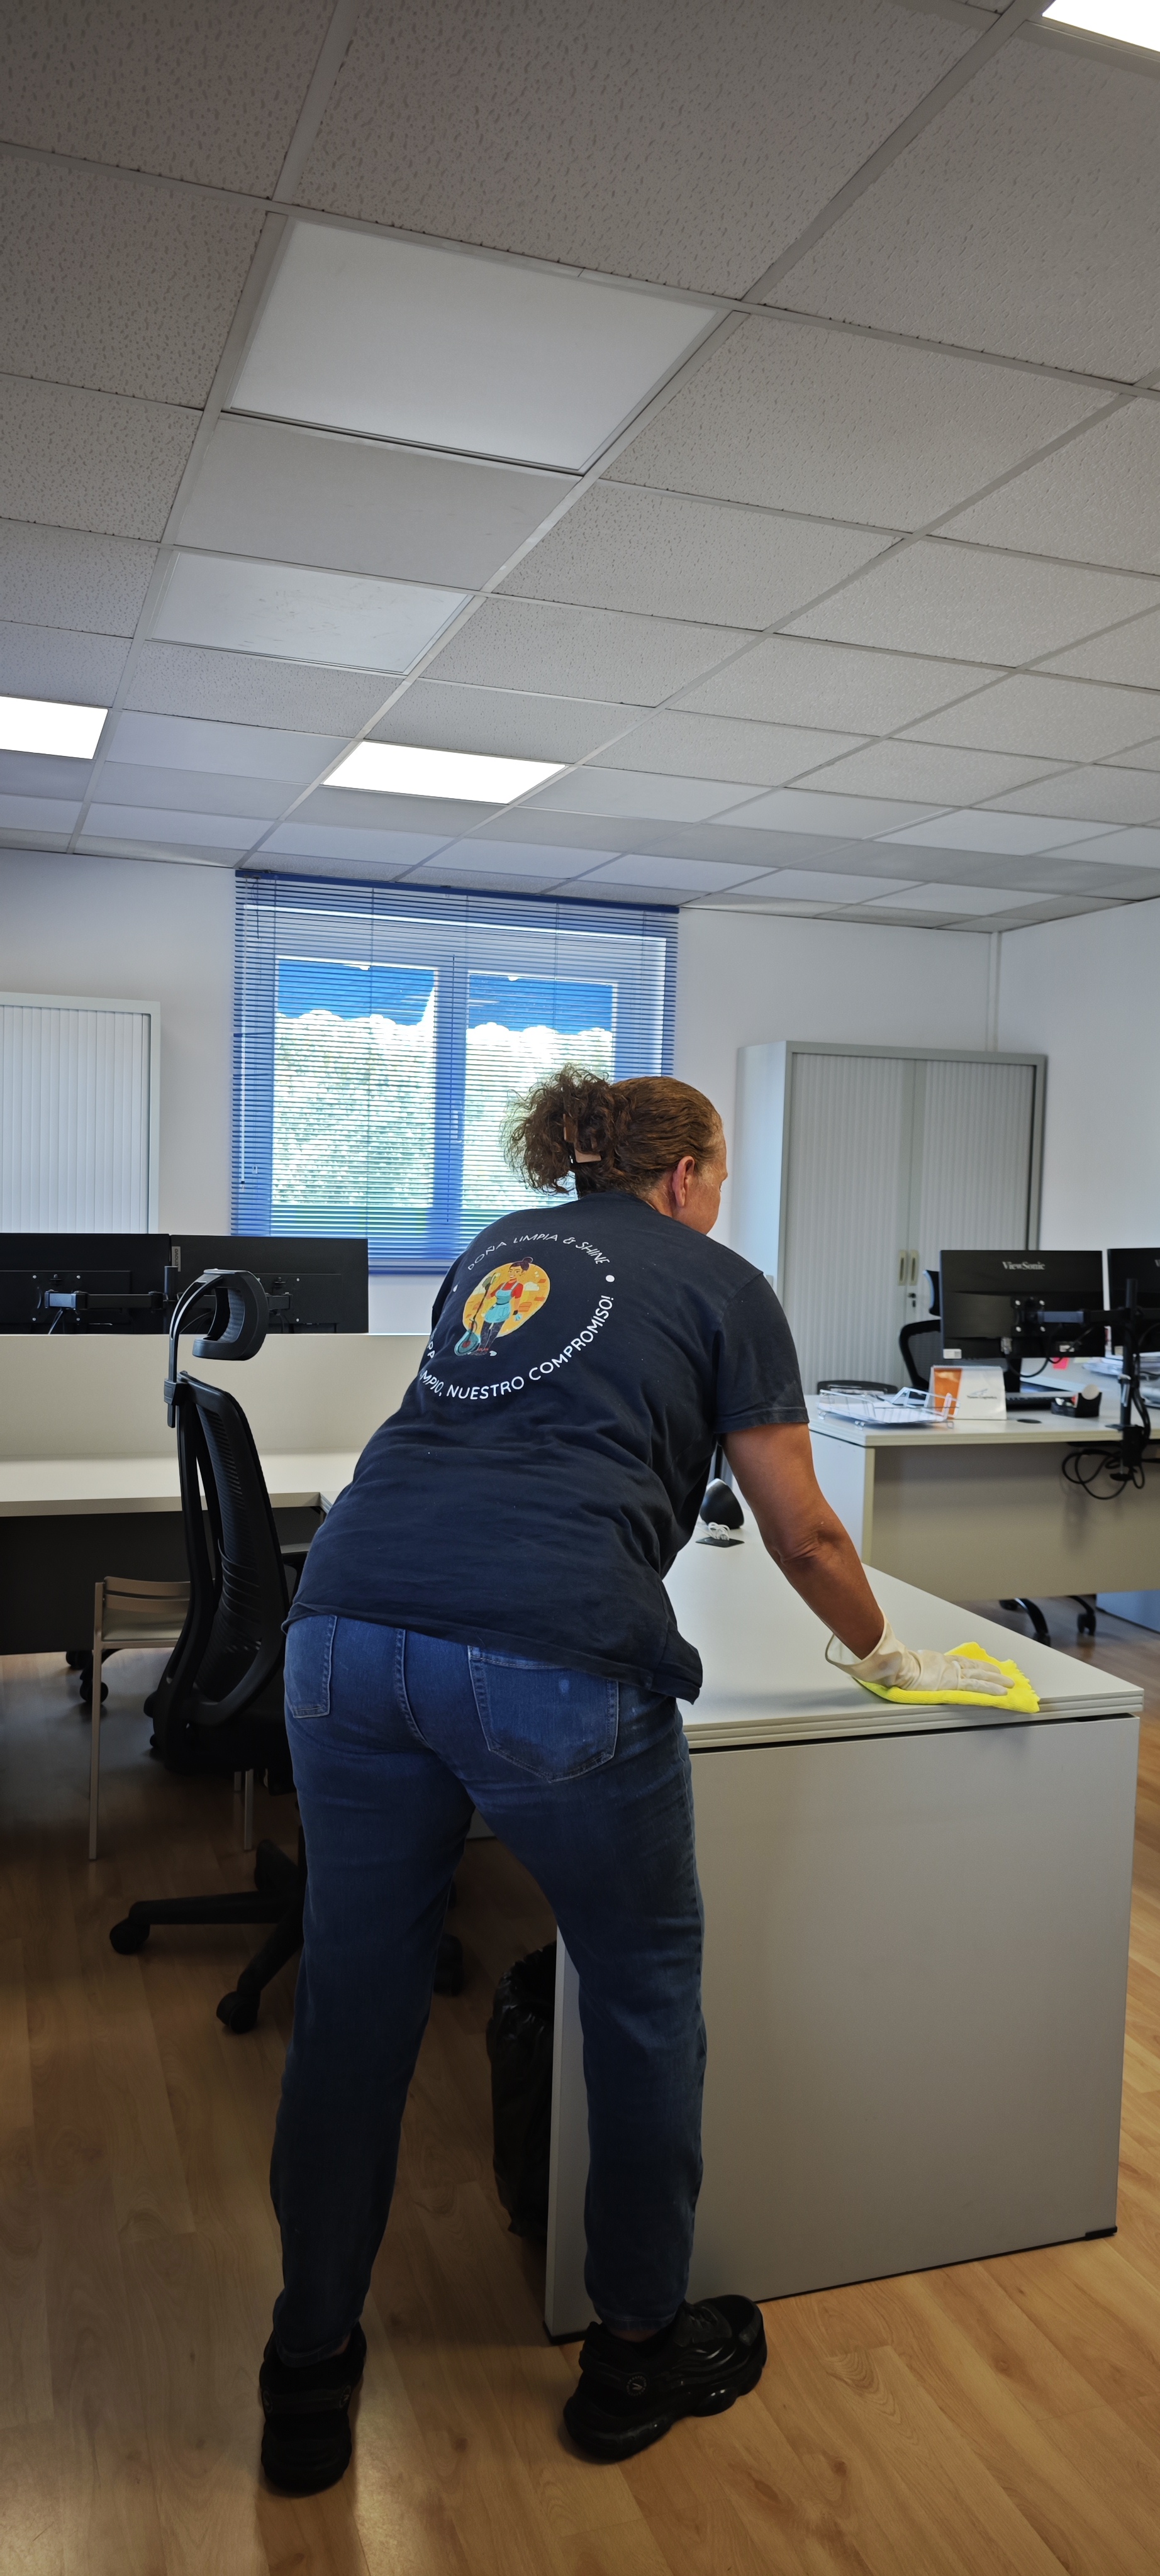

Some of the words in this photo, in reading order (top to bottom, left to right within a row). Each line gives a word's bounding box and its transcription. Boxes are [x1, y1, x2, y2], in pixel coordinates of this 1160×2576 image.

[467, 1241, 507, 1270] DOÑA
[513, 1233, 558, 1243] LIMPIA
[562, 1236, 576, 1245] &
[575, 1241, 610, 1265] SHINE
[1002, 1261, 1046, 1270] ViewSonic
[420, 1370, 444, 1396] MPIO,
[446, 1376, 525, 1400] NUESTRO
[528, 1295, 614, 1380] COMPROMISO!
